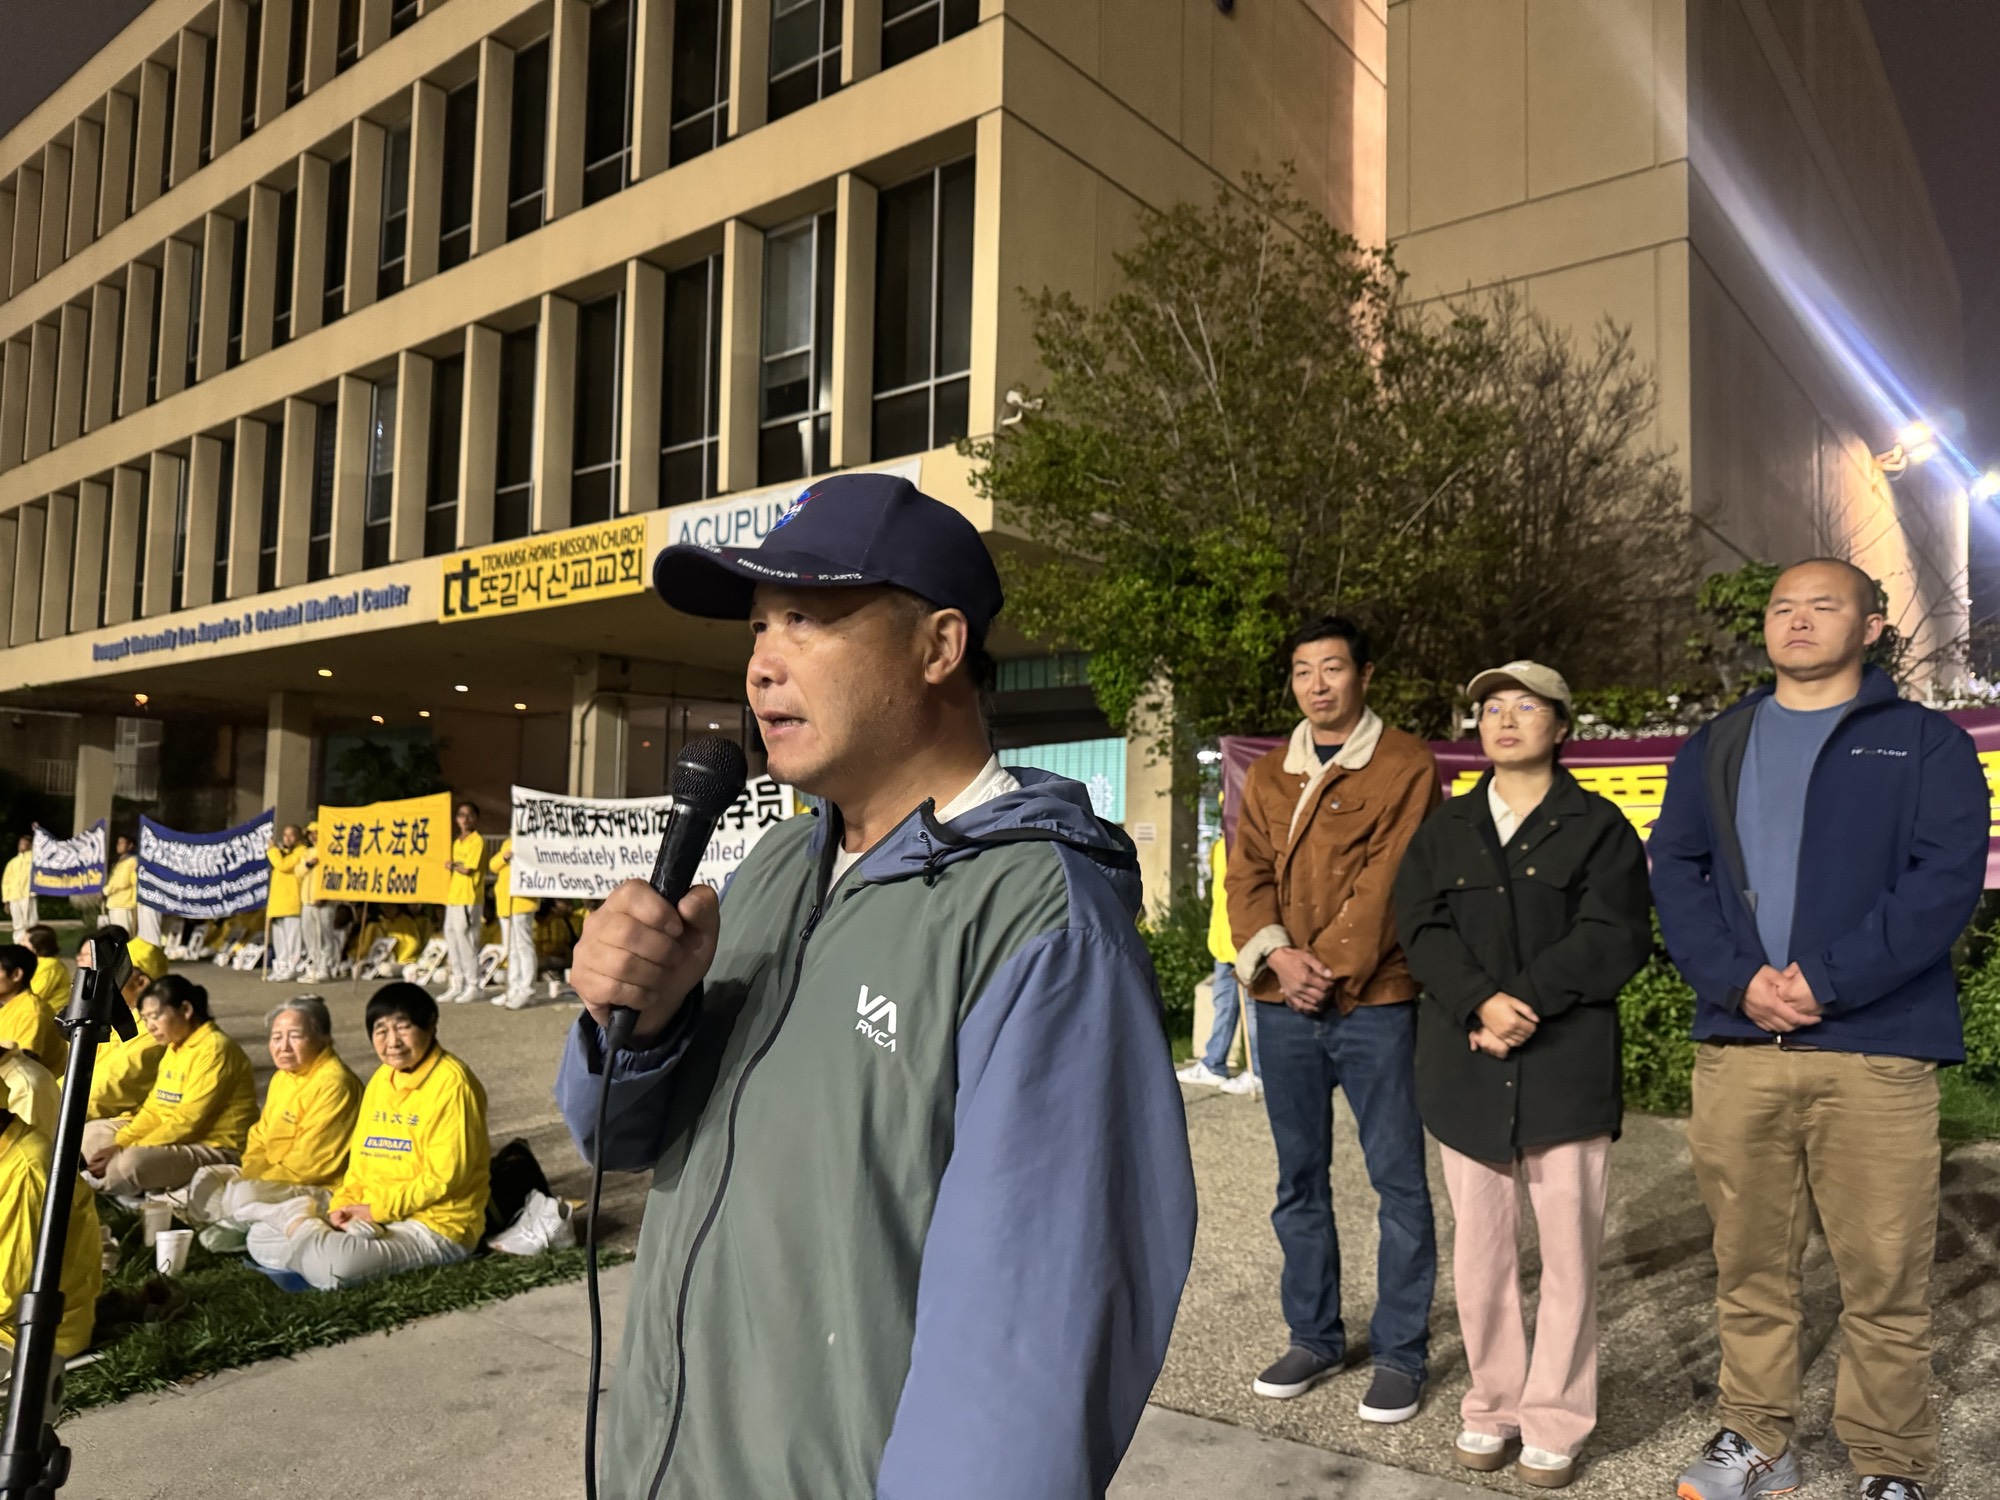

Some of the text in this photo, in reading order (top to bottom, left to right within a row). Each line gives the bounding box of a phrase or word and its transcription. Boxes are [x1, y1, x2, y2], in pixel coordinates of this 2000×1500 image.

[529, 541, 557, 562] HOME
[559, 532, 600, 556] MISSION
[600, 525, 644, 551] CHURCH
[243, 612, 253, 634] &
[255, 602, 303, 632] Oriental
[305, 591, 359, 623] Medical
[362, 582, 411, 612] Center
[534, 845, 616, 870] Immediately
[702, 838, 746, 862] ailed
[387, 865, 419, 894] Good
[519, 870, 556, 890] Falun
[558, 872, 596, 896] Gong
[855, 1019, 896, 1053] RVCA
